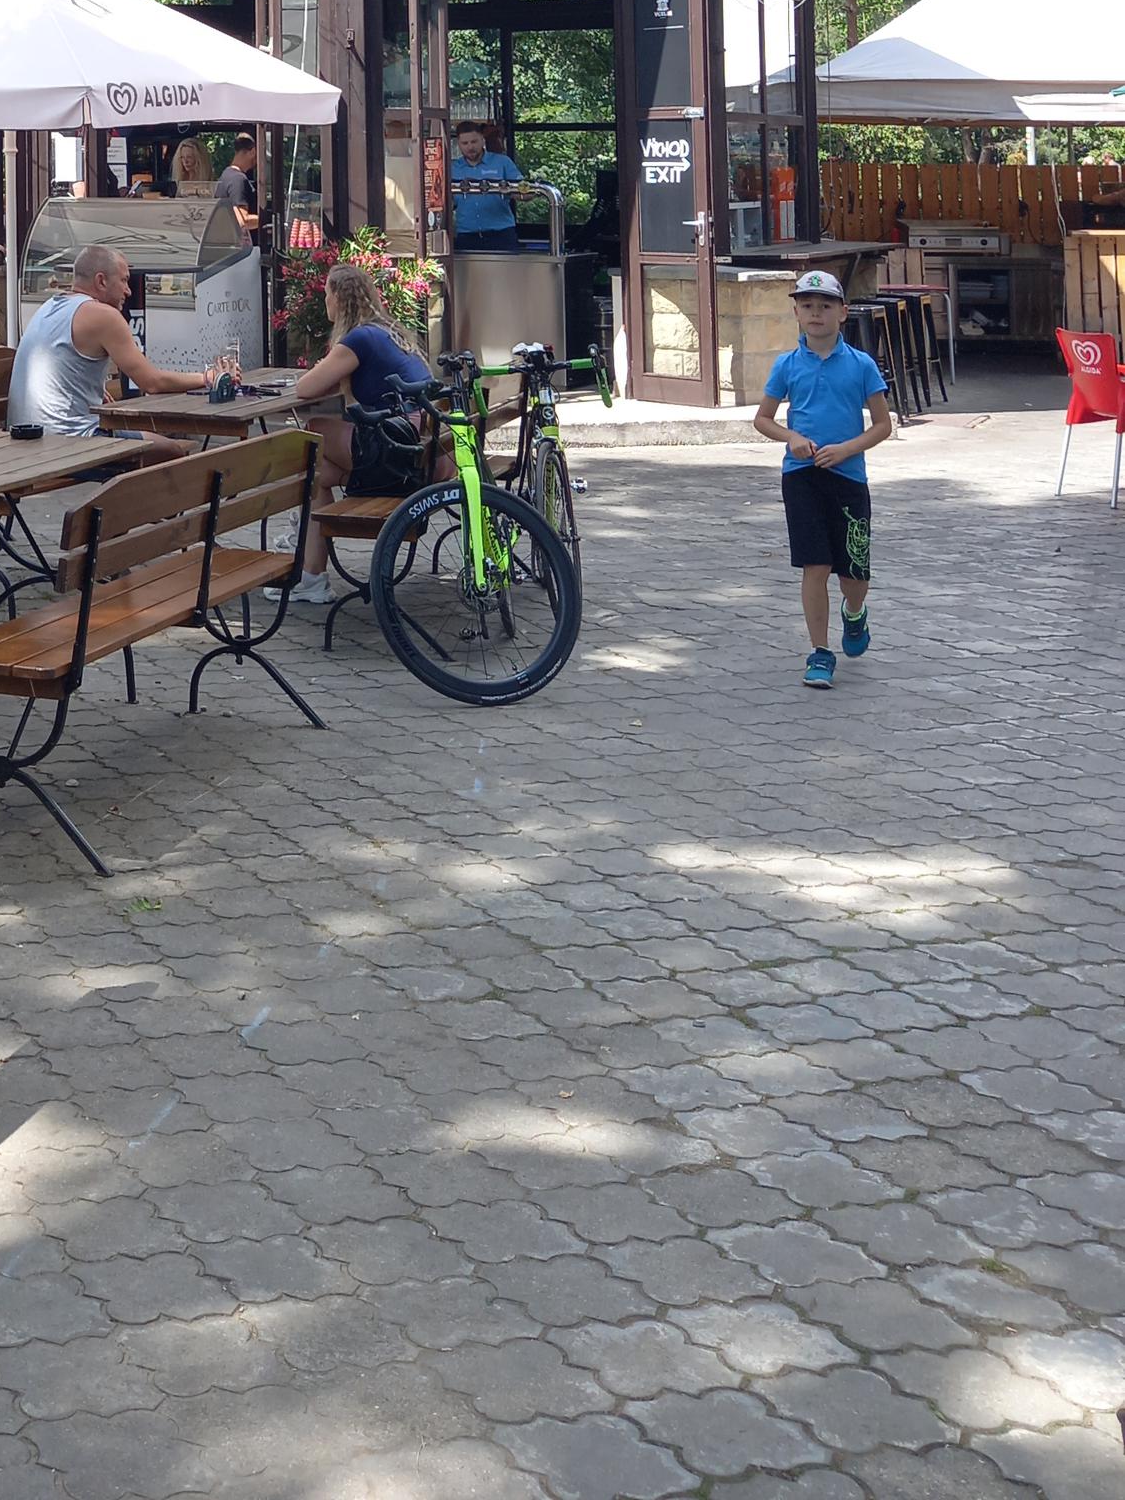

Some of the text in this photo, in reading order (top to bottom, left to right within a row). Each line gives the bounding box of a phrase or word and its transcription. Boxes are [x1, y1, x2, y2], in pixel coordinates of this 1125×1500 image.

[144, 84, 200, 107] ALGIDA
[646, 166, 683, 184] EXIT
[207, 301, 230, 317] CARTE
[408, 489, 460, 519] DT SWISS
